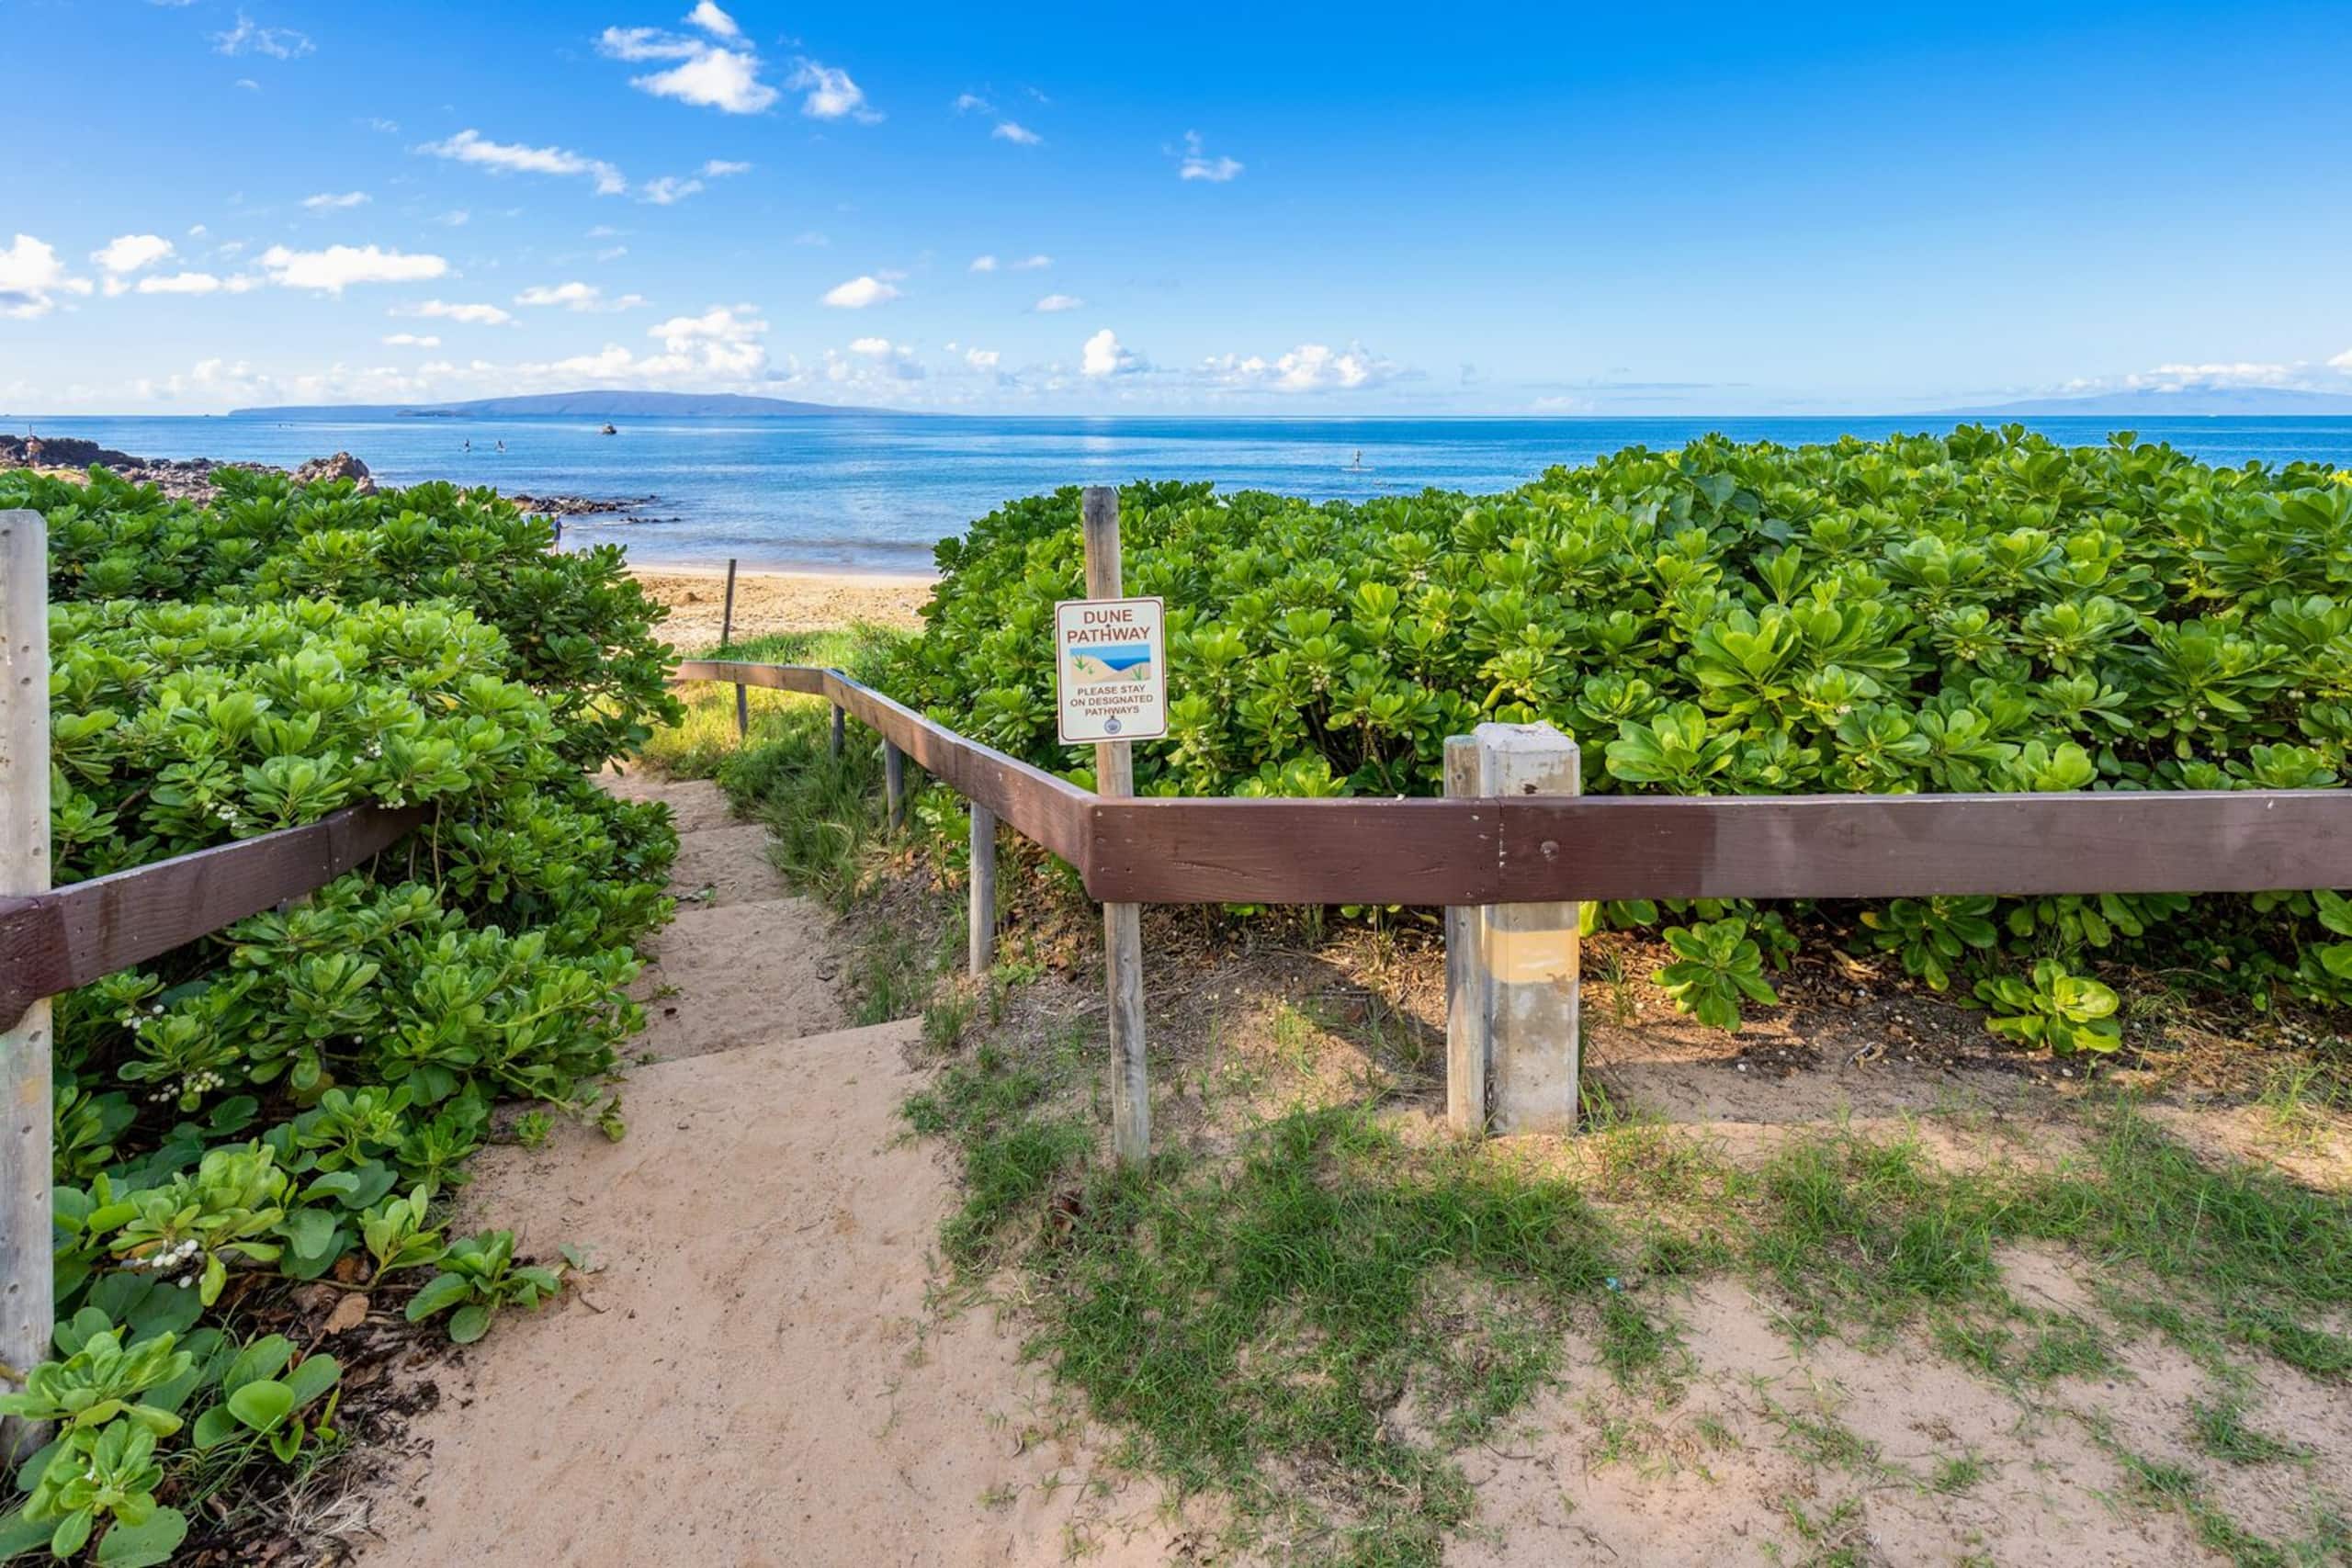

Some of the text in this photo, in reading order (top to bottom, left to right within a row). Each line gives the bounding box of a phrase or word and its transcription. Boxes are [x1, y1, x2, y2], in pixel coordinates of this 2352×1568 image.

[1084, 609, 1133, 624] DUNE
[1067, 626, 1150, 643] PATHWAY
[1078, 683, 1146, 696] PLEASE STAY
[1069, 694, 1153, 707] ON DESIGNATED
[1085, 705, 1139, 716] PATHWAYS
